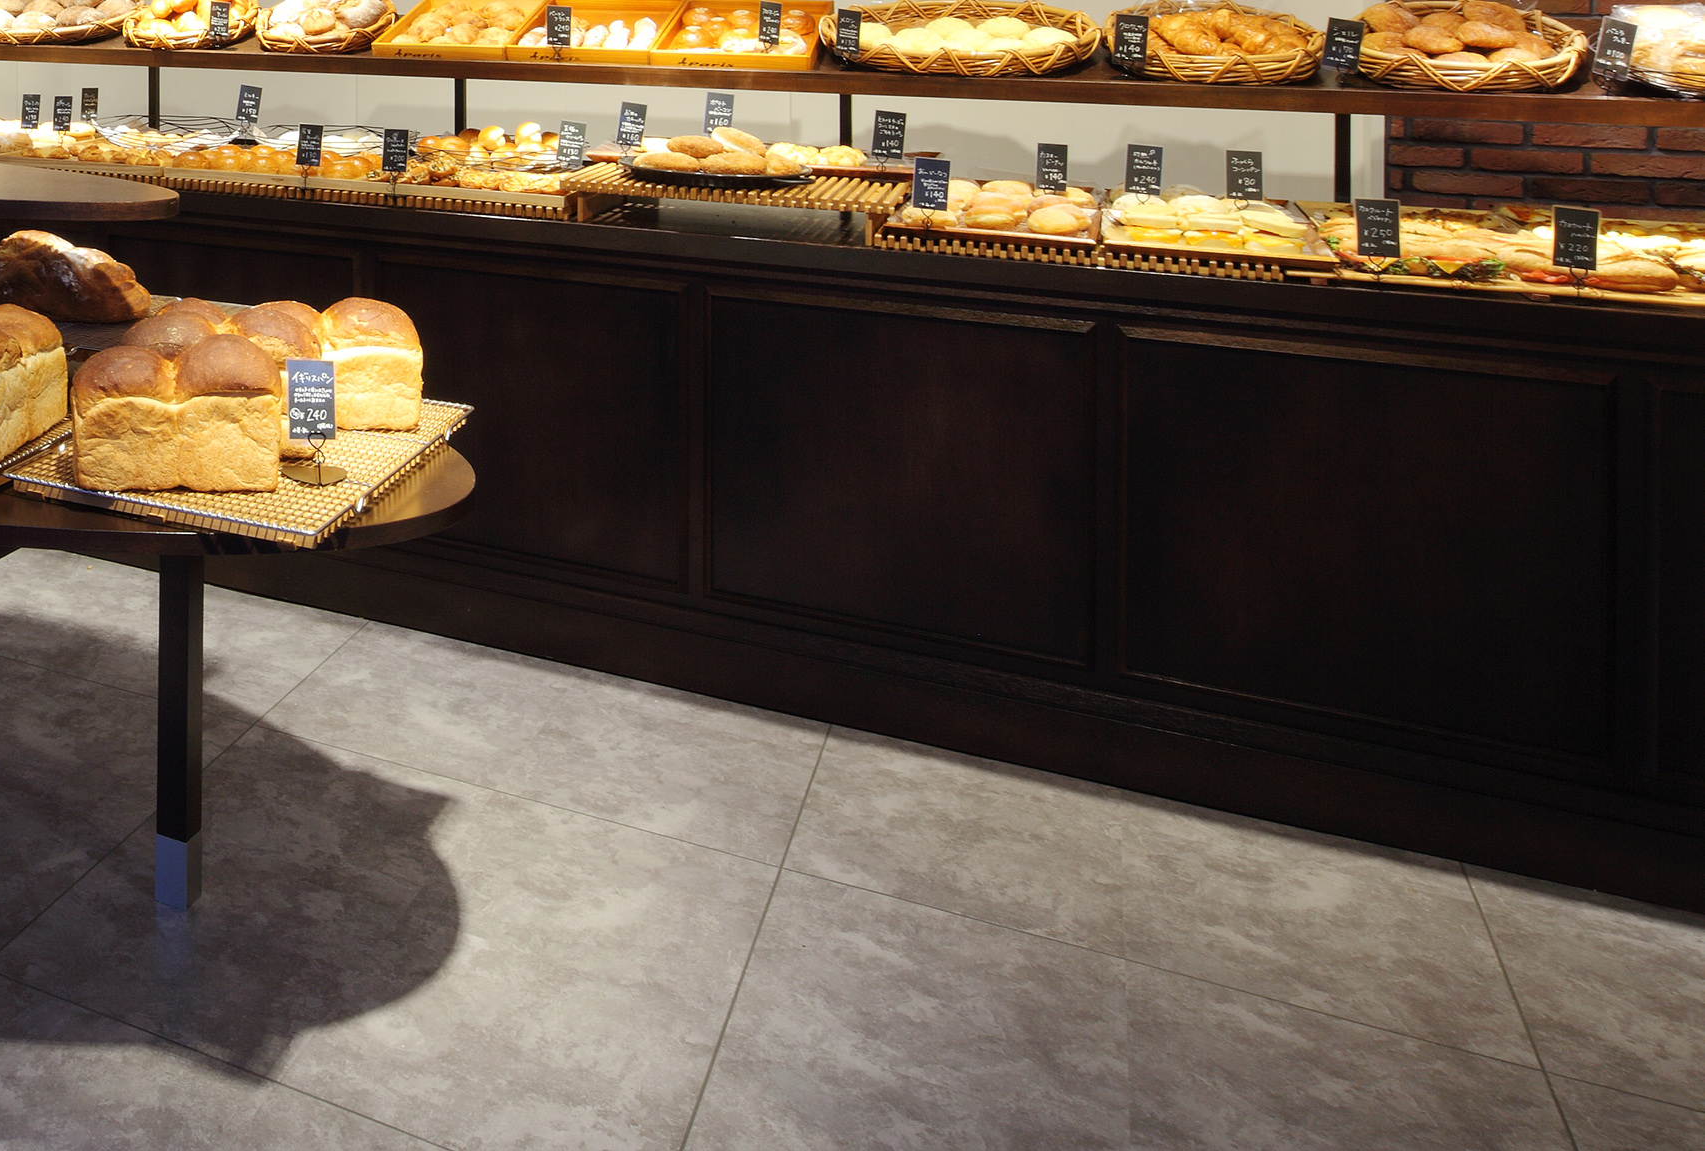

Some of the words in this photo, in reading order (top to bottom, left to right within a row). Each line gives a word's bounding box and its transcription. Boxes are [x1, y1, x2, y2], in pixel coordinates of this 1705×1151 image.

[291, 370, 334, 385] イギリスパン
